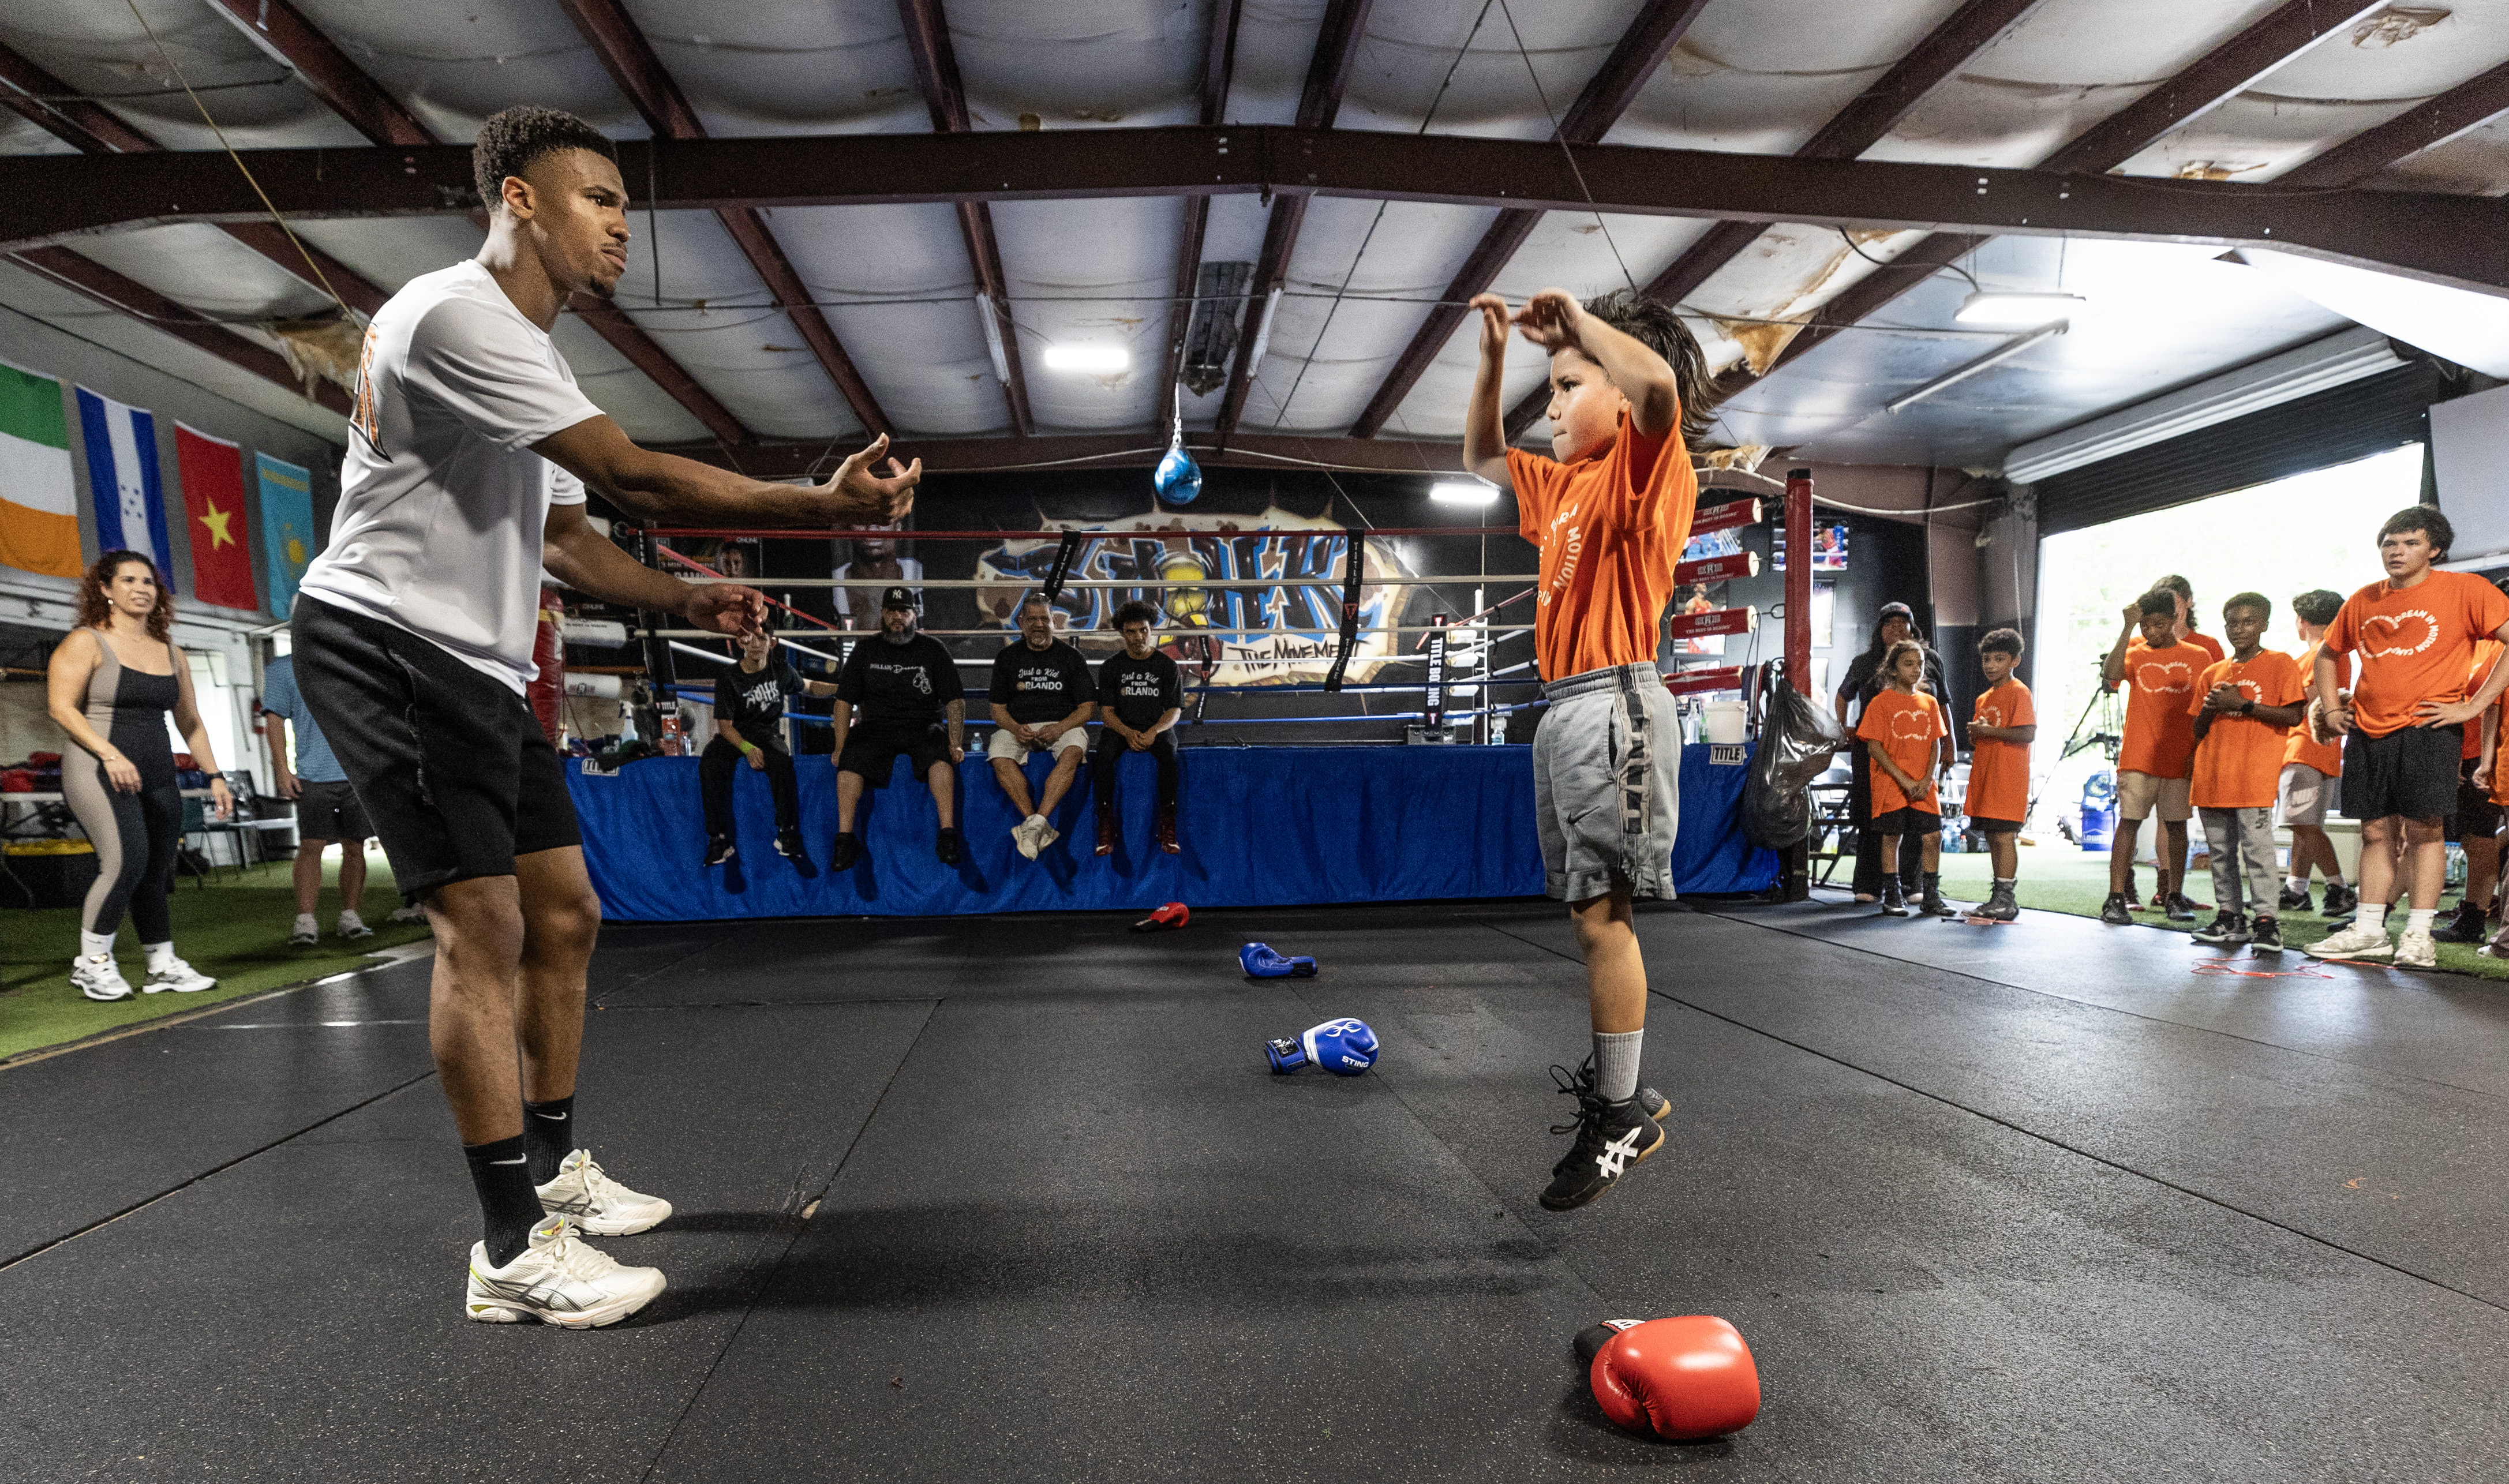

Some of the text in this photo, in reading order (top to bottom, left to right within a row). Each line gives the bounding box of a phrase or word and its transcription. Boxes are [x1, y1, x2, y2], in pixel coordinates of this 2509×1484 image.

[2395, 609, 2428, 623] DREAM
[1018, 668, 1035, 678] Just
[1044, 668, 1060, 678] Kid
[1122, 672, 1136, 684] Just
[1144, 672, 1159, 684] Kid
[1428, 637, 1443, 706] TITLE BOING
[1715, 747, 1740, 760] TITLE
[1342, 1055, 1369, 1068] STING
